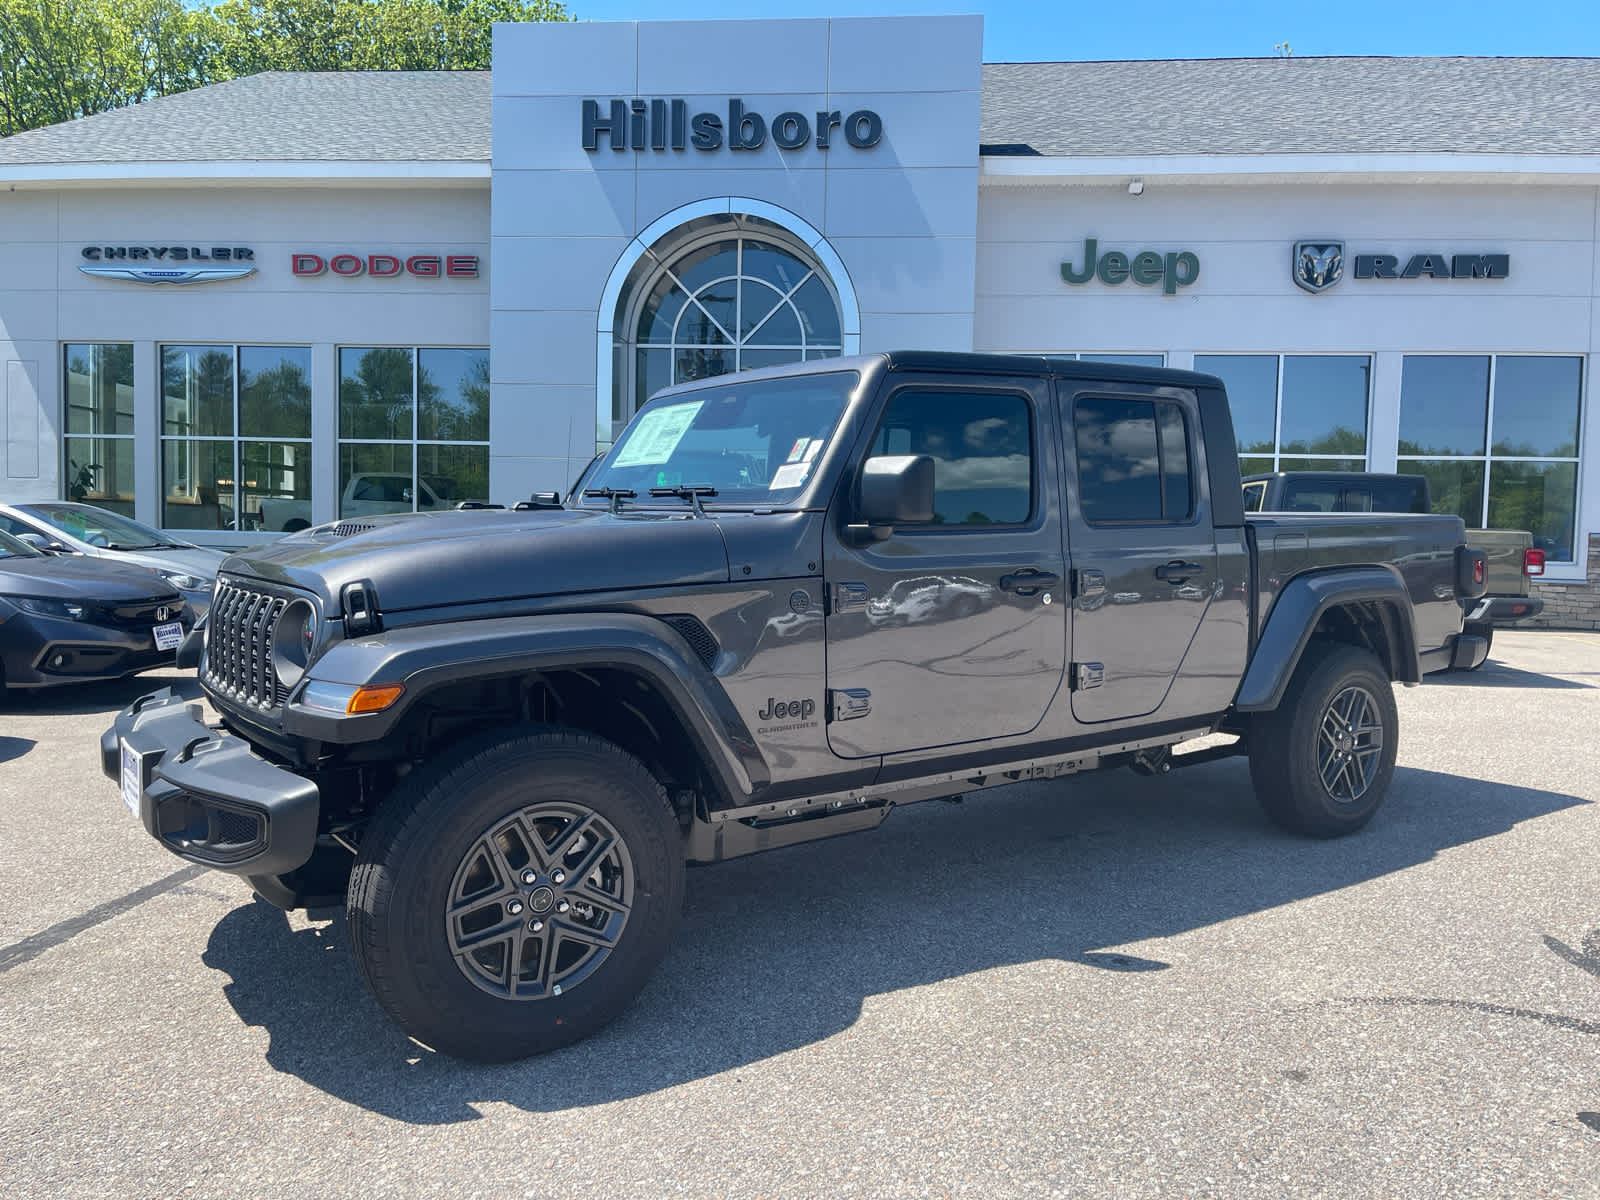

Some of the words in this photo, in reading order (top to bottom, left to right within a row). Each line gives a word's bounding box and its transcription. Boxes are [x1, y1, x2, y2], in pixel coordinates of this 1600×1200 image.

[581, 98, 883, 151] Hillsboro
[80, 246, 255, 261] CHRYSLER
[292, 254, 480, 278] DODGE
[1060, 238, 1200, 295] Jeep
[1354, 254, 1510, 279] RAM
[759, 697, 816, 721] Jeep
